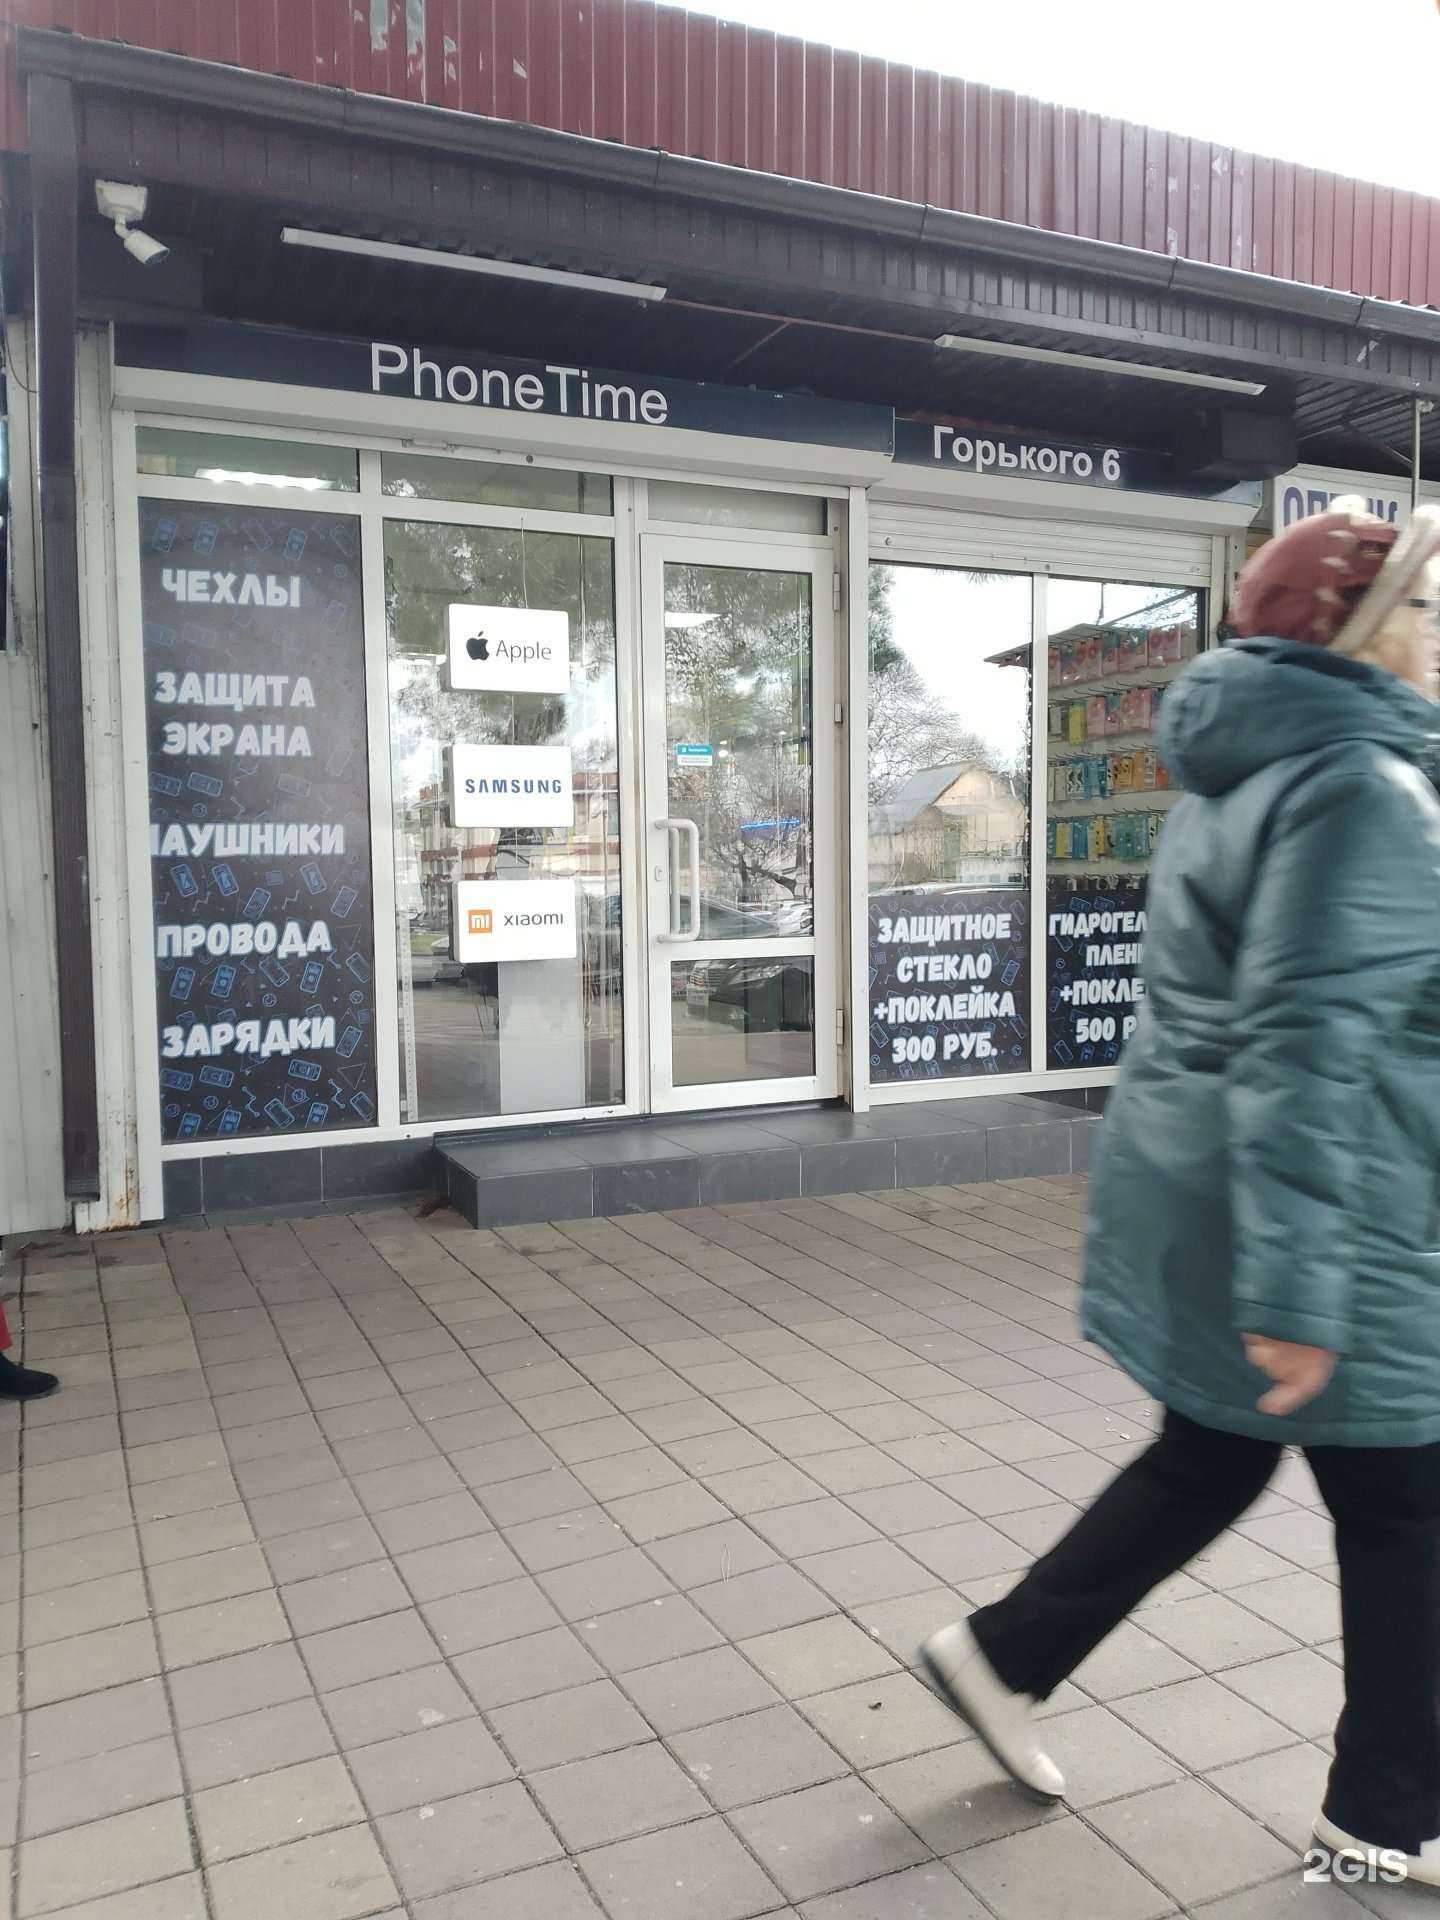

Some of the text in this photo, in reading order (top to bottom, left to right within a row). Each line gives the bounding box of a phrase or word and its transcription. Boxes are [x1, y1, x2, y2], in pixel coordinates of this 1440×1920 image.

[370, 342, 669, 424] PhoneTime
[933, 425, 1121, 481] Горького 6
[161, 568, 302, 608] ЧЕХЛЫ
[495, 639, 552, 663] Apple
[155, 672, 317, 714] ЗАЩИТА
[162, 722, 312, 757] ЭКРАНА
[464, 777, 562, 796] SAMSUNG
[156, 921, 332, 960] ПРОВОДА
[877, 913, 1012, 947] ЗАЩИТНОЕ
[1048, 911, 1149, 938] ГИДРОГЕЛ
[897, 953, 993, 984] СТЕКЛО
[873, 985, 1016, 1024] +ПОКЛЕЙКА
[1060, 978, 1146, 1005] +ПОКЛЕ
[161, 1016, 335, 1058] ЗАРЯДКИ
[1076, 1016, 1115, 1043] 500
[892, 1031, 998, 1064] 300 РУБ.
